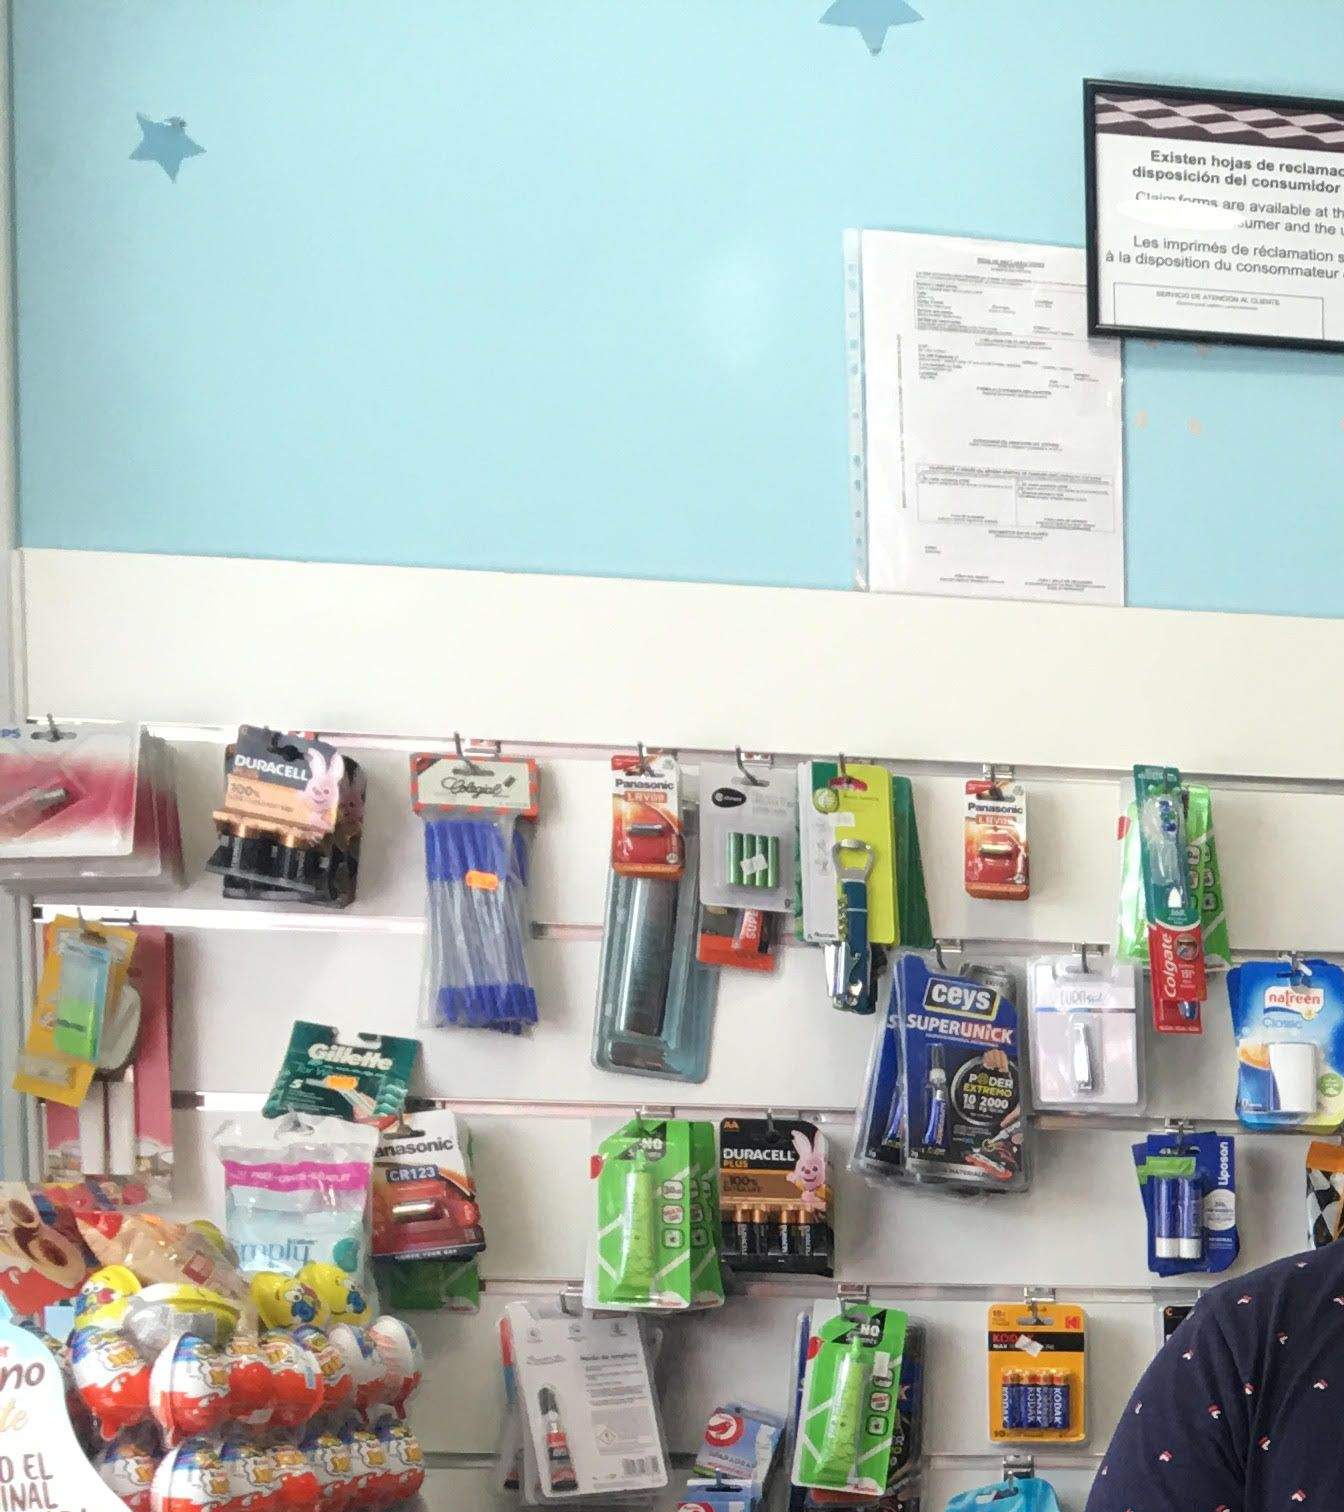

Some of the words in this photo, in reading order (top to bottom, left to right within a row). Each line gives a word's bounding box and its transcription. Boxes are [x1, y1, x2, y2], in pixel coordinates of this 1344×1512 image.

[1150, 149, 1206, 165] Existen
[1211, 155, 1252, 171] hojas
[1256, 157, 1275, 172] de
[1132, 165, 1220, 186] disposición
[1225, 172, 1247, 187] del
[1252, 176, 1340, 194] consumidor
[1222, 199, 1245, 212] are
[1250, 201, 1311, 217] available
[1316, 207, 1329, 219] at
[1285, 219, 1310, 233] and
[1314, 222, 1337, 235] the
[1133, 235, 1159, 249] Les
[1163, 237, 1228, 255] imprimés
[1232, 242, 1249, 255] de
[1253, 243, 1333, 263] réclamation
[1119, 251, 1131, 265] la
[1135, 252, 1210, 273] disposition
[1215, 258, 1232, 271] du
[1236, 262, 1340, 281] consommateur
[234, 754, 309, 782] DURACELL
[615, 779, 675, 790] Panasonic
[967, 802, 1023, 815] Panasonic
[1161, 933, 1178, 998] Colgate
[932, 983, 991, 1010] ceys
[307, 1043, 393, 1071] Gillette
[963, 1093, 977, 1104] 10
[980, 1095, 1009, 1110] 2000
[723, 1148, 795, 1163] DURACELL
[723, 1160, 749, 1169] PLUS
[388, 1167, 438, 1182] CR123
[1054, 1387, 1062, 1425] KODAK
[24, 1452, 54, 1481] EL
